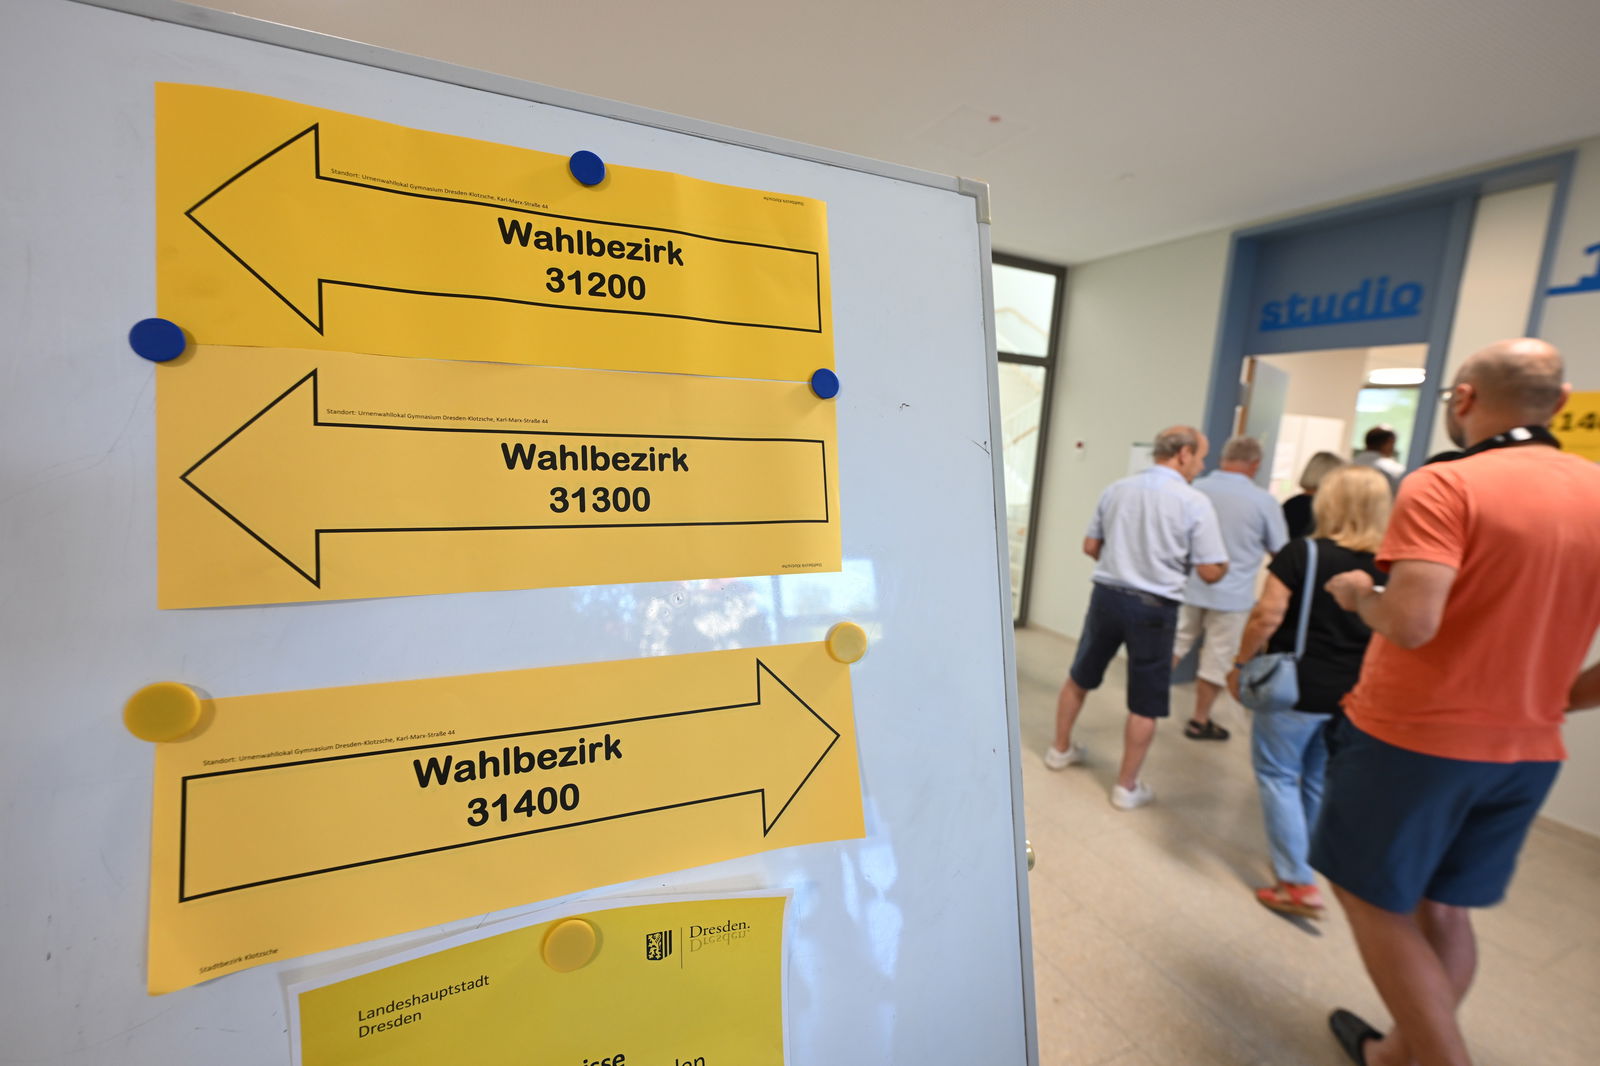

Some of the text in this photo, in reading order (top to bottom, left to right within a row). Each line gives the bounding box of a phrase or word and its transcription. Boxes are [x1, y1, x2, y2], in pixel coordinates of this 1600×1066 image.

[331, 168, 360, 179] Standort:
[361, 174, 409, 188] Urnenwahllokal
[409, 183, 444, 194] Gymnasium
[497, 217, 684, 266] Wahlbezirk
[545, 267, 646, 300] 31200
[1259, 275, 1425, 331] studio
[326, 408, 357, 416] Standort:
[358, 410, 406, 419] Urnenwahllokal
[406, 412, 442, 421] Gymnasium
[1547, 411, 1600, 432] 14
[500, 442, 689, 472] Wahlbezirk
[549, 487, 651, 513] 31300
[203, 756, 237, 766] Standort:
[238, 749, 293, 762] Urnenwahllokal
[294, 743, 334, 755] Gymnasium
[335, 736, 395, 749] Dresden-Klotzsche,
[396, 730, 447, 742] Karl-Marx-Straße
[413, 733, 623, 788] Wahlbezirk
[467, 783, 580, 827] 31400
[689, 919, 751, 939] Dresden.
[358, 975, 490, 1022] Landeshauptstadt
[358, 1011, 422, 1039] Dresden
